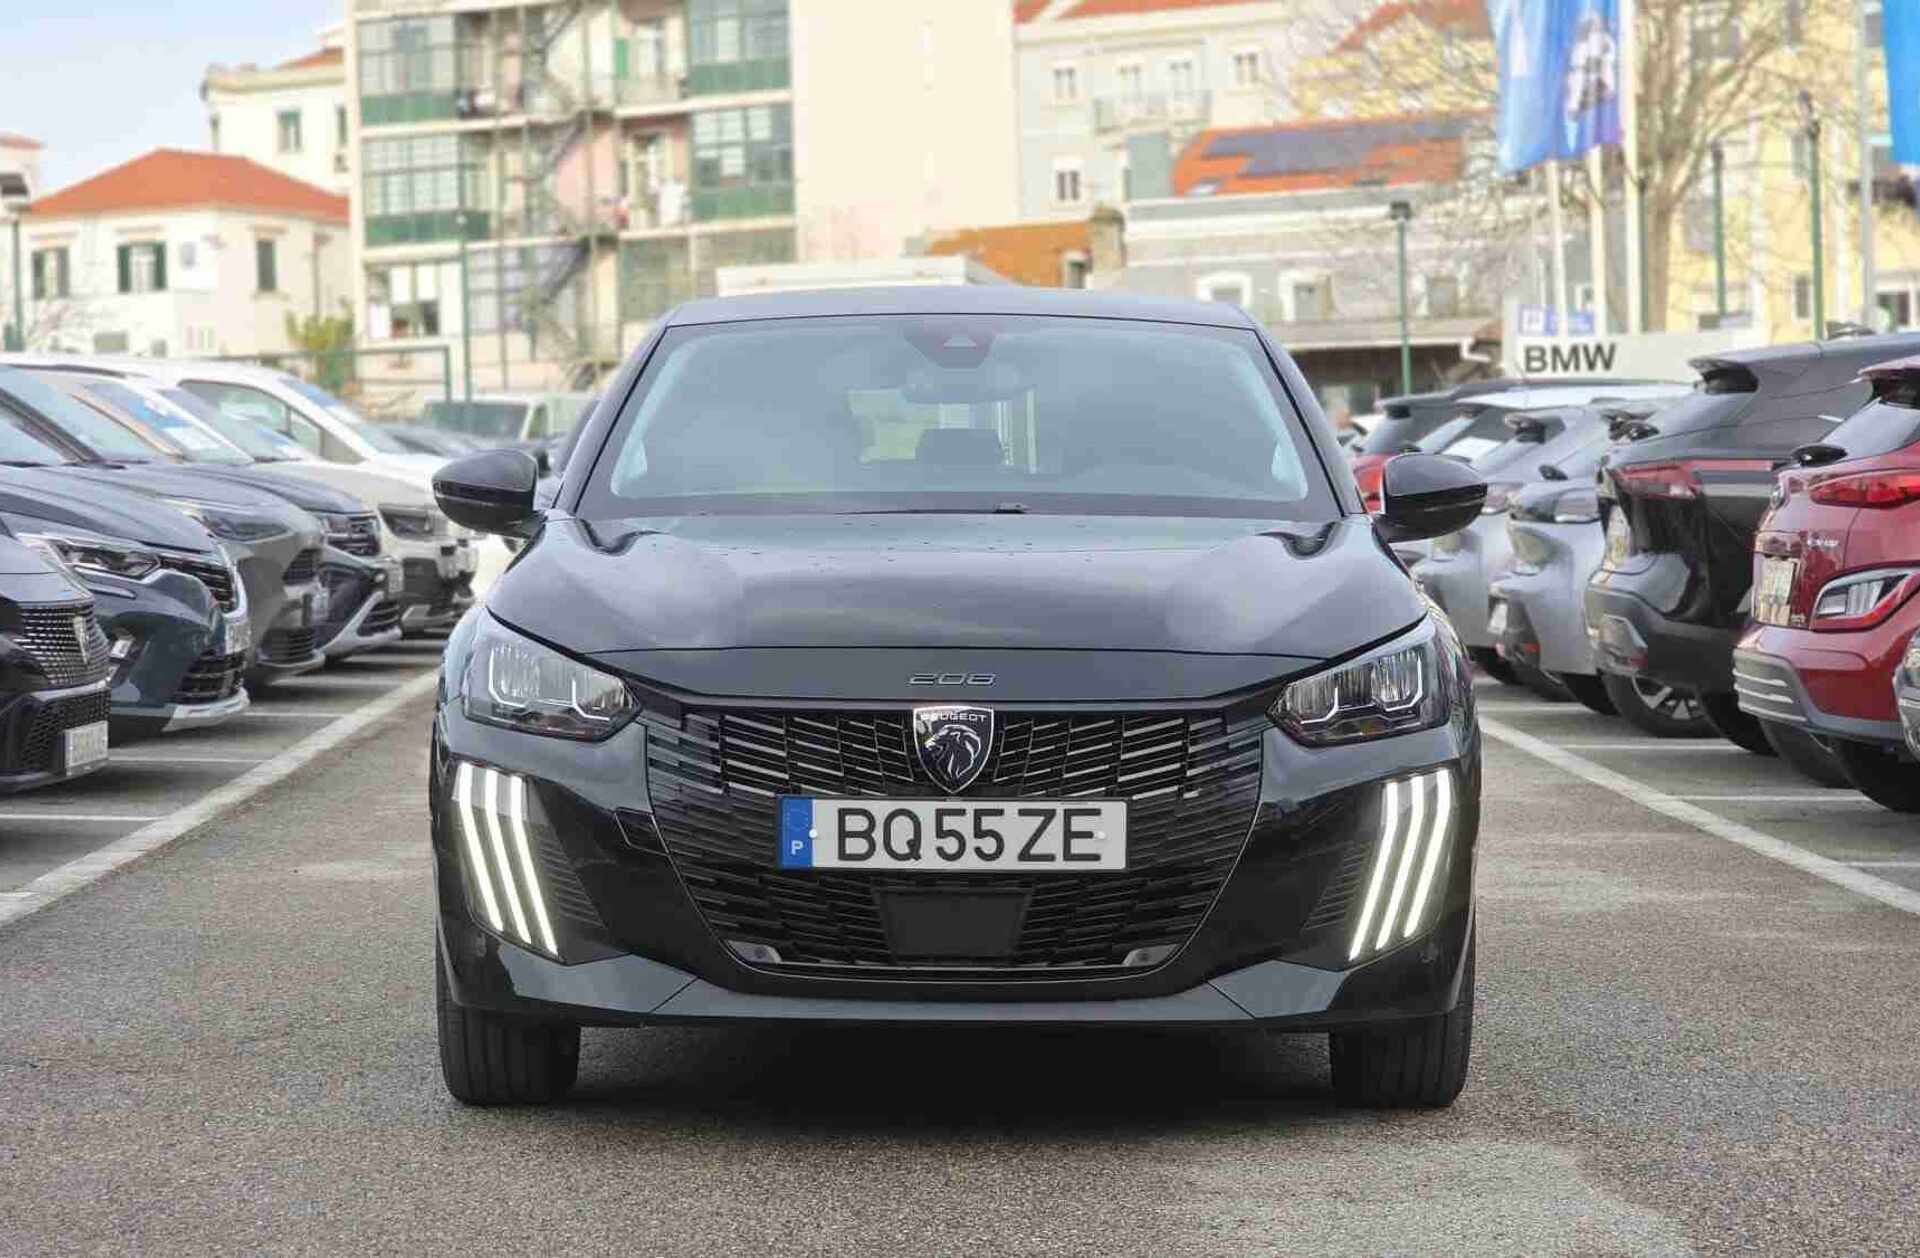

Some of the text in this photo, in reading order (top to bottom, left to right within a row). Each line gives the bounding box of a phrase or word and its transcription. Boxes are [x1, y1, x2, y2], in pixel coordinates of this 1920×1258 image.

[1525, 343, 1616, 373] BMW
[908, 672, 997, 686] 208
[920, 712, 987, 722] PEUGEOT
[790, 840, 804, 856] P
